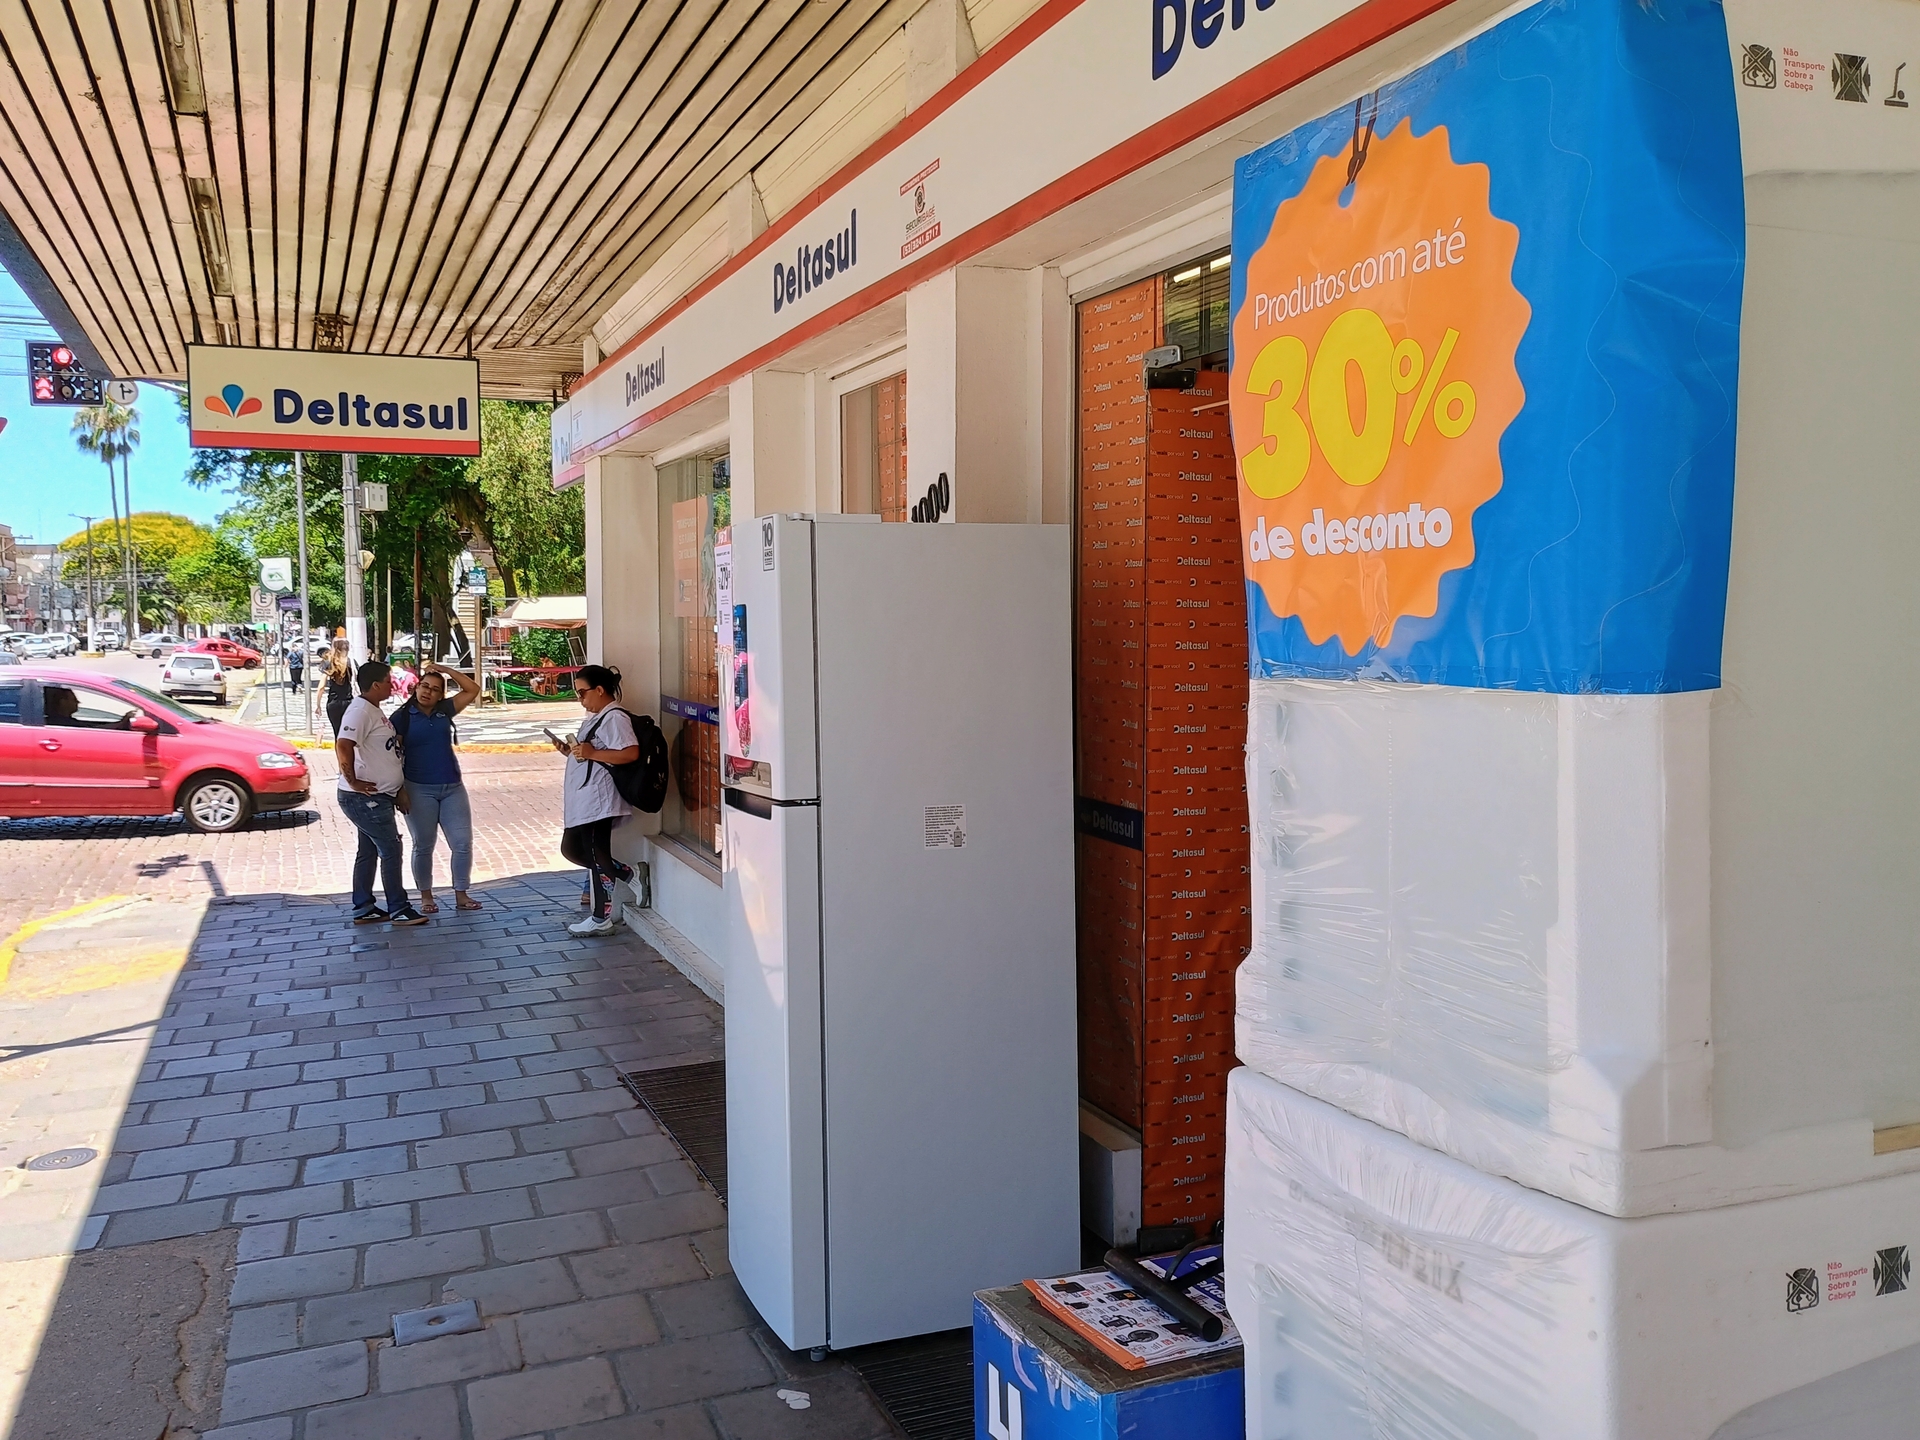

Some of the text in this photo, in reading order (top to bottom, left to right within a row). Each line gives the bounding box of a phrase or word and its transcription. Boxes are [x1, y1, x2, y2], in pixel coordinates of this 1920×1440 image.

[1782, 48, 1799, 57] Não
[1784, 58, 1826, 72] Transporte
[1784, 70, 1808, 80] Sobre
[1784, 80, 1814, 92] Cabeça
[774, 208, 858, 314] Deltasul
[1254, 216, 1466, 330] Produtos com até
[626, 346, 666, 408] Deltasul
[1241, 308, 1476, 500] 30%
[274, 388, 468, 431] Deltasul
[1180, 428, 1213, 438] Deltasul
[1179, 472, 1212, 481] Deltasul
[1178, 514, 1211, 524] Deltasul
[762, 522, 773, 548] 10
[1249, 502, 1452, 562] de desconto
[1177, 556, 1210, 566] Deltasul
[1176, 599, 1210, 608] Deltasul
[1175, 641, 1208, 650] Deltasul
[1175, 683, 1208, 692] Deltasul
[1174, 724, 1206, 733] Deltasul
[1173, 765, 1207, 775] Deltasul
[1173, 807, 1206, 816] Deltasul
[1093, 810, 1134, 838] Deltasul
[1172, 848, 1205, 858] Deltasul
[1827, 1262, 1842, 1270] Não
[1828, 1267, 1868, 1280] Transporte
[1828, 1282, 1850, 1291] Sobre
[1828, 1291, 1856, 1301] Cabeça
